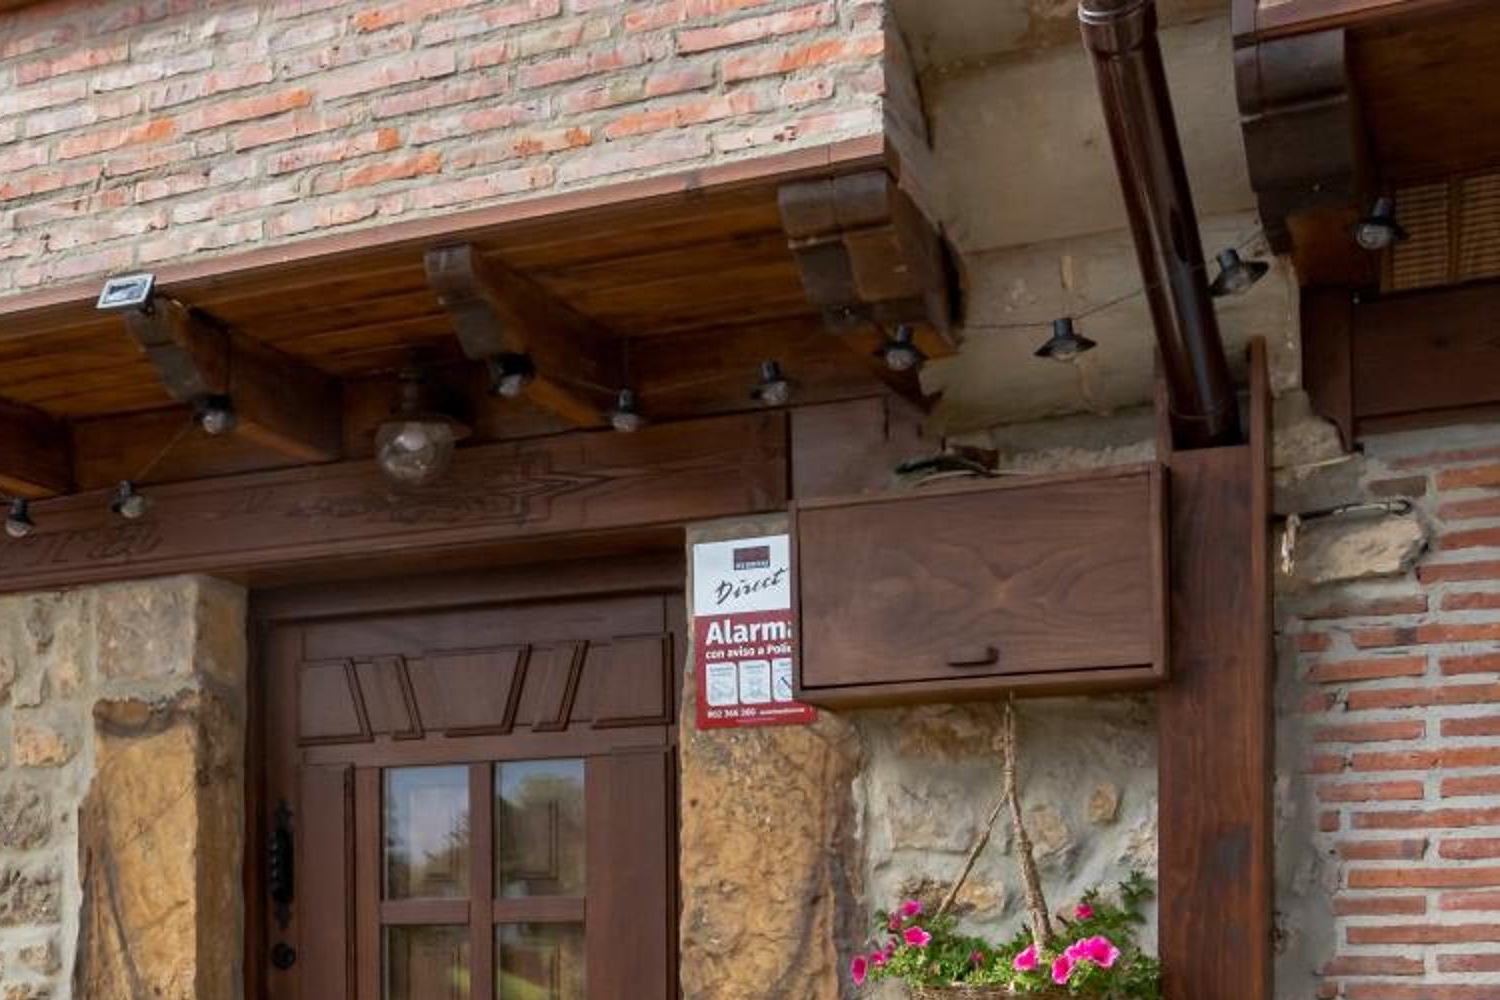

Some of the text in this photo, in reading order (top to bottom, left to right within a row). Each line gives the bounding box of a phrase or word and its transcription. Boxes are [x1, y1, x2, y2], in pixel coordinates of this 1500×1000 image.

[716, 567, 788, 605] Direct
[705, 649, 724, 659] con
[727, 645, 755, 657] aviso
[757, 646, 765, 655] a
